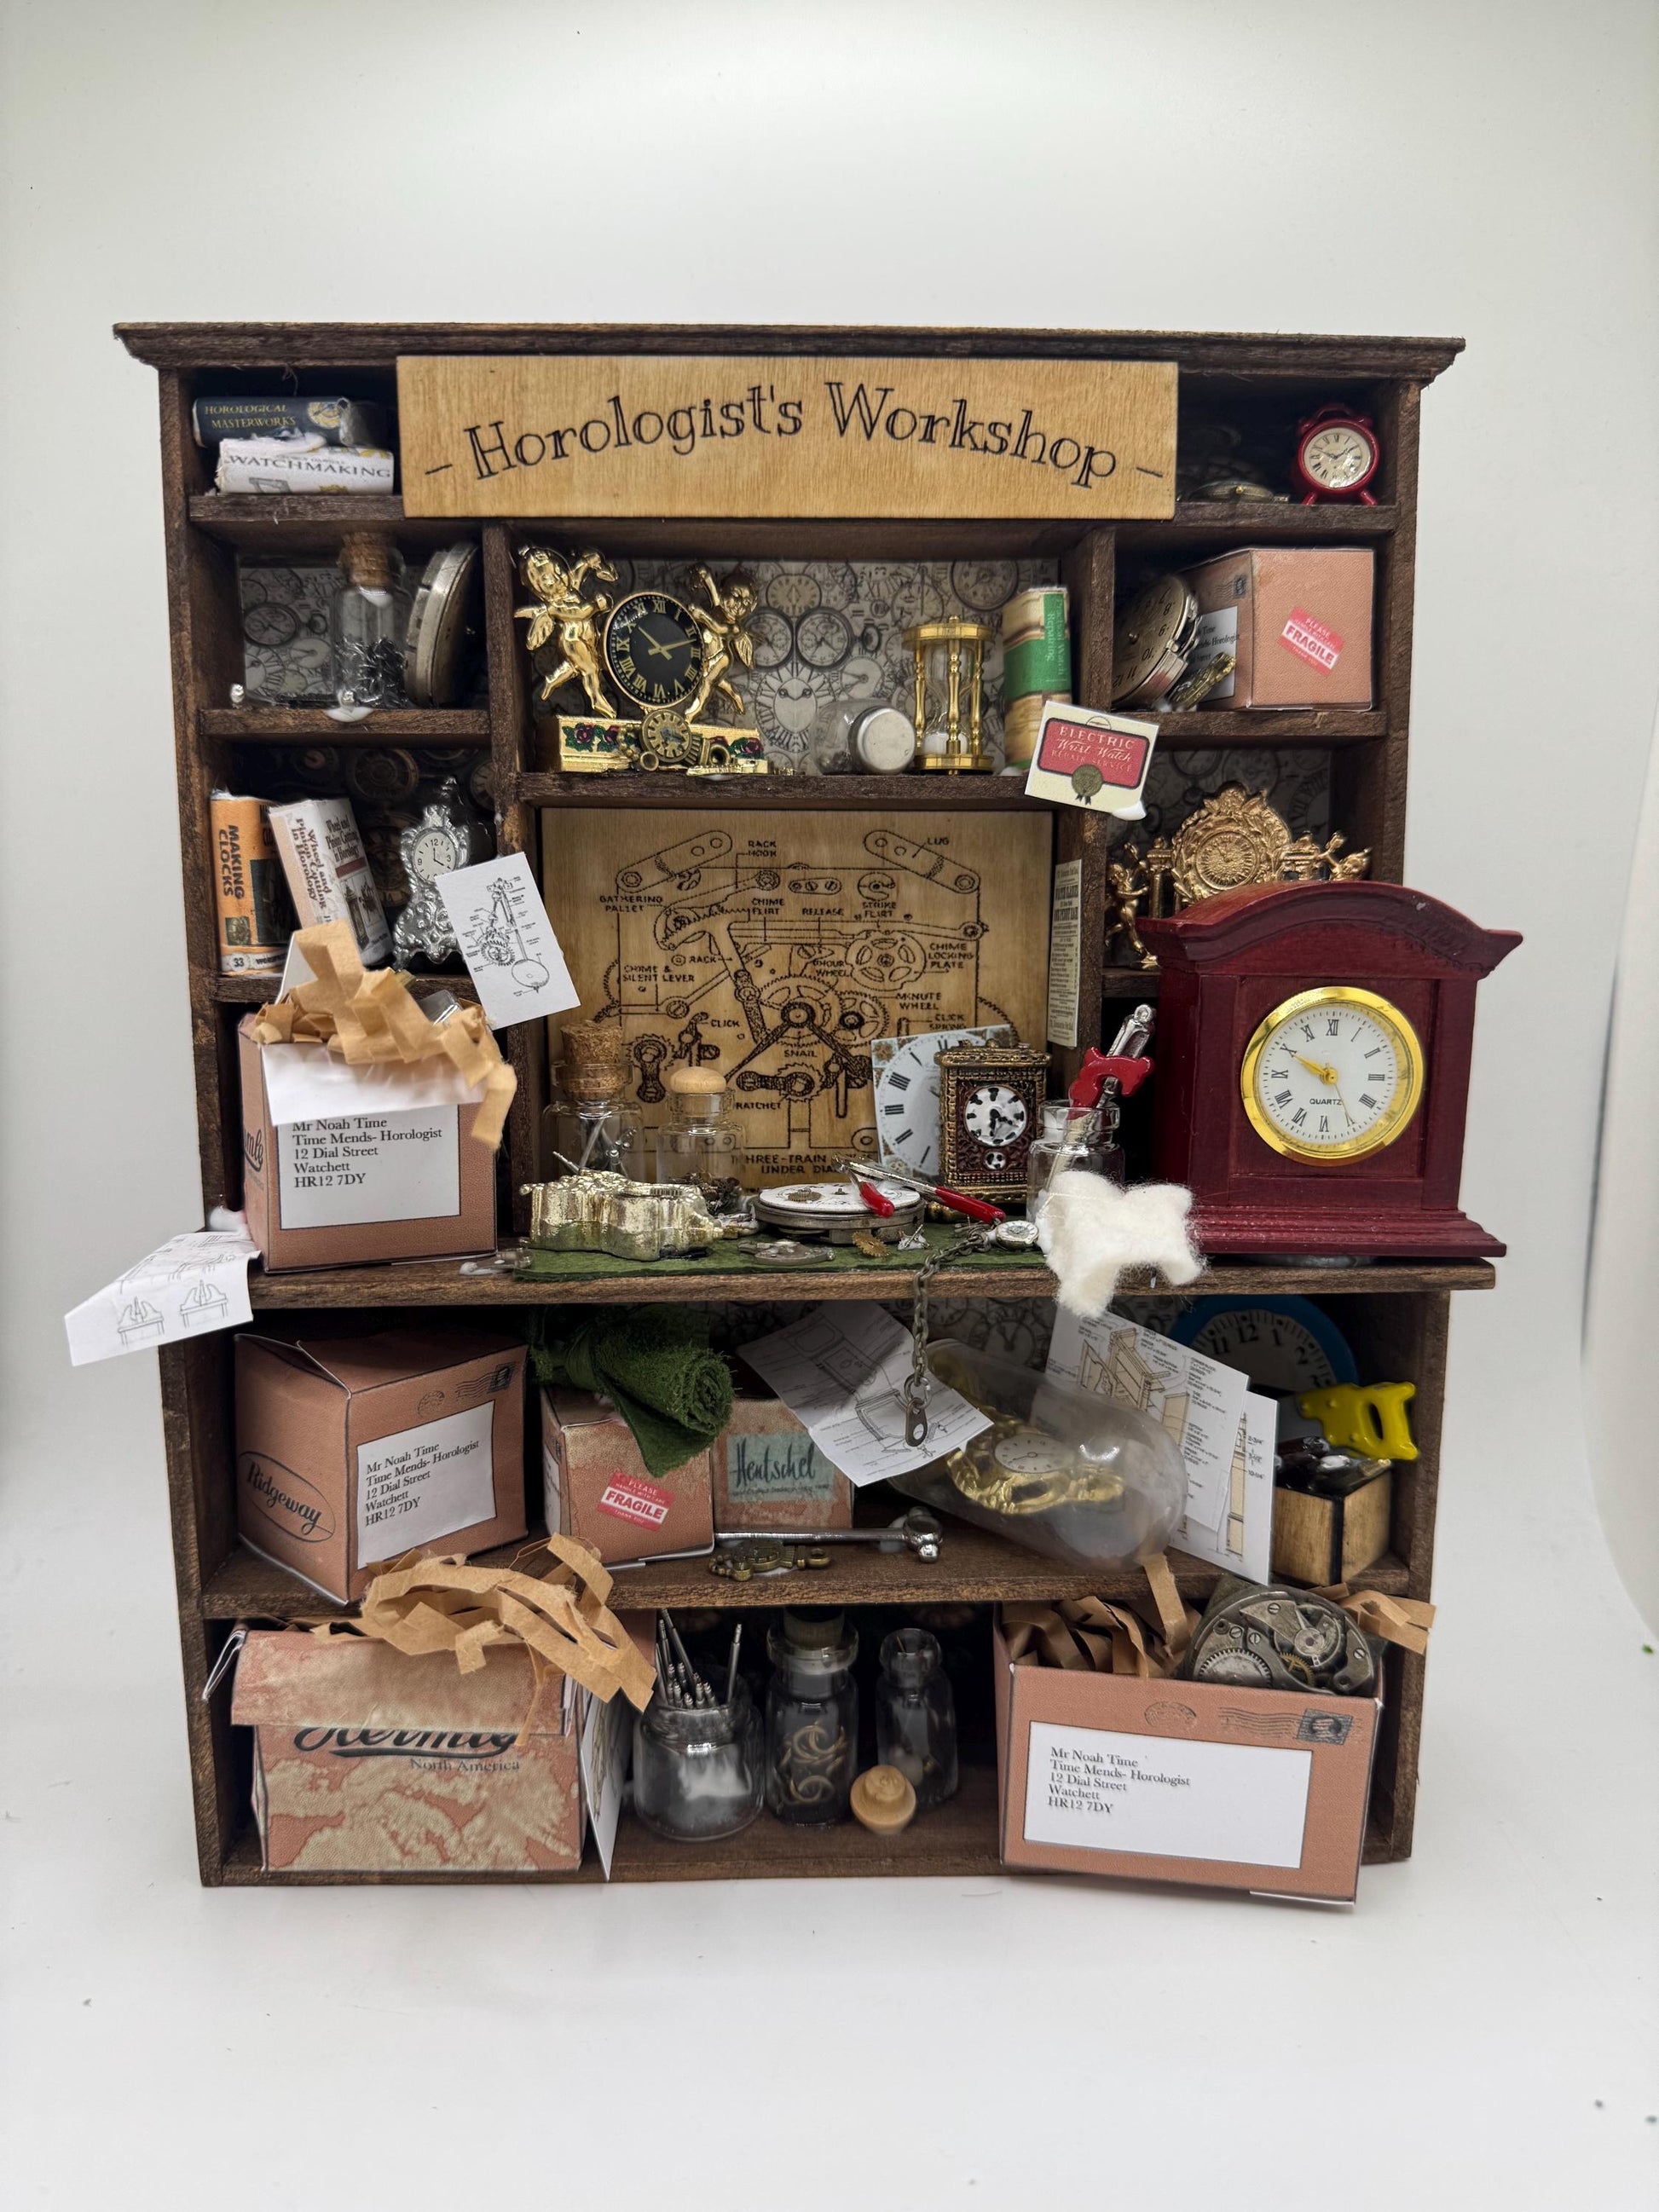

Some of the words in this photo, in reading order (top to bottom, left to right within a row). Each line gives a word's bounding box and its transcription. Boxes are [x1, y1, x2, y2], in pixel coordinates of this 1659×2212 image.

[205, 404, 288, 415] HOROLOGICAL
[211, 416, 297, 429] MASTERWORKS
[465, 385, 802, 479] Horologist's
[824, 382, 1117, 488] Workshop
[228, 455, 390, 478] WATCHMAKING
[1305, 618, 1330, 638] PLEASE
[1045, 613, 1056, 662] Repairing
[1286, 625, 1334, 665] FRAGILE
[1060, 726, 1136, 748] ELECTRIC
[1057, 738, 1091, 754] Wrist
[1098, 747, 1132, 763] Watch
[1051, 749, 1086, 762] REPAIR
[1092, 759, 1132, 772] SERVICE
[430, 838, 440, 846] 12
[927, 837, 950, 846] LUG
[218, 829, 234, 897] CLOCKS
[228, 824, 245, 900] MAKING
[308, 829, 324, 868] Wheel
[319, 871, 332, 893] and
[296, 844, 318, 901] Horology
[309, 862, 327, 910] Cutting
[599, 895, 663, 904] GATHERING
[752, 898, 784, 906] CHIME
[752, 907, 780, 915] FLIRT
[801, 908, 844, 916] RELEASE
[864, 910, 893, 918] FLIRT
[929, 943, 967, 951] CHIME
[234, 957, 245, 967] 33
[689, 956, 717, 964] RACK
[928, 952, 974, 961] LOCKING
[930, 961, 964, 969] PLATE
[622, 973, 658, 982] SILENT
[624, 965, 658, 973] CHIME
[664, 965, 672, 973] &
[896, 992, 941, 1001] MINUTE
[899, 1002, 939, 1010] WHEEL
[934, 1014, 965, 1022] CLICK
[1300, 1024, 1315, 1042] XI
[1326, 1019, 1339, 1037] XII
[1350, 1027, 1361, 1042] I
[783, 1049, 818, 1058] SNAIL
[1280, 1043, 1297, 1058] X
[1364, 1048, 1381, 1059] II
[1271, 1069, 1288, 1079] IX
[736, 1101, 781, 1110] RATCHET
[1275, 1089, 1293, 1109] VIII
[1359, 1094, 1377, 1109] IIII
[292, 1123, 314, 1132] Mr
[316, 1119, 350, 1130] Noah
[353, 1118, 388, 1129] Time
[1292, 1107, 1308, 1127] VII
[1319, 1115, 1329, 1133] VI
[1344, 1112, 1356, 1128] V
[292, 1135, 327, 1146] Time
[331, 1132, 377, 1144] Mends-
[380, 1128, 443, 1142] Horologist
[295, 1148, 309, 1160] 12
[313, 1147, 338, 1158] Dial
[343, 1146, 379, 1157] Street
[293, 1163, 350, 1174] Watchett
[761, 1165, 806, 1174] UNDER
[294, 1175, 333, 1187] HR12
[338, 1173, 367, 1186] 7DY
[1238, 1325, 1259, 1344] 12
[1272, 1330, 1282, 1347] 1
[1211, 1338, 1230, 1355] 11
[1294, 1346, 1309, 1366] 2
[1309, 1375, 1320, 1388] 3
[366, 1472, 392, 1487] Time
[394, 1458, 431, 1477] Mends-
[432, 1440, 480, 1464] Horologist
[367, 1461, 383, 1475] Mr
[384, 1451, 412, 1469] Noah
[413, 1442, 440, 1458] Time
[729, 1437, 816, 1487] Hentschel
[367, 1487, 378, 1501] 12
[380, 1479, 401, 1495] Dial
[402, 1470, 431, 1487] Street
[628, 1480, 657, 1496] PLEASE
[246, 1461, 322, 1536] Ridgeway
[366, 1490, 410, 1513] Watchett
[606, 1491, 664, 1520] FRAGILE
[365, 1506, 396, 1528] HR12
[398, 1496, 422, 1514] 7DY
[410, 1757, 453, 1771] North
[457, 1759, 521, 1772] America
[1050, 1747, 1070, 1759] Mr
[1072, 1749, 1104, 1764] Noah
[1107, 1753, 1139, 1768] Time
[1050, 1759, 1081, 1773] Time
[1084, 1764, 1127, 1778] Mends-
[1130, 1769, 1191, 1788] Horologist
[1050, 1772, 1064, 1783] 12
[1066, 1773, 1090, 1787] Dial
[1093, 1777, 1128, 1792] Street
[1049, 1783, 1101, 1800] Watchett
[1048, 1795, 1084, 1811] HR12
[1087, 1800, 1114, 1814] 7DY
